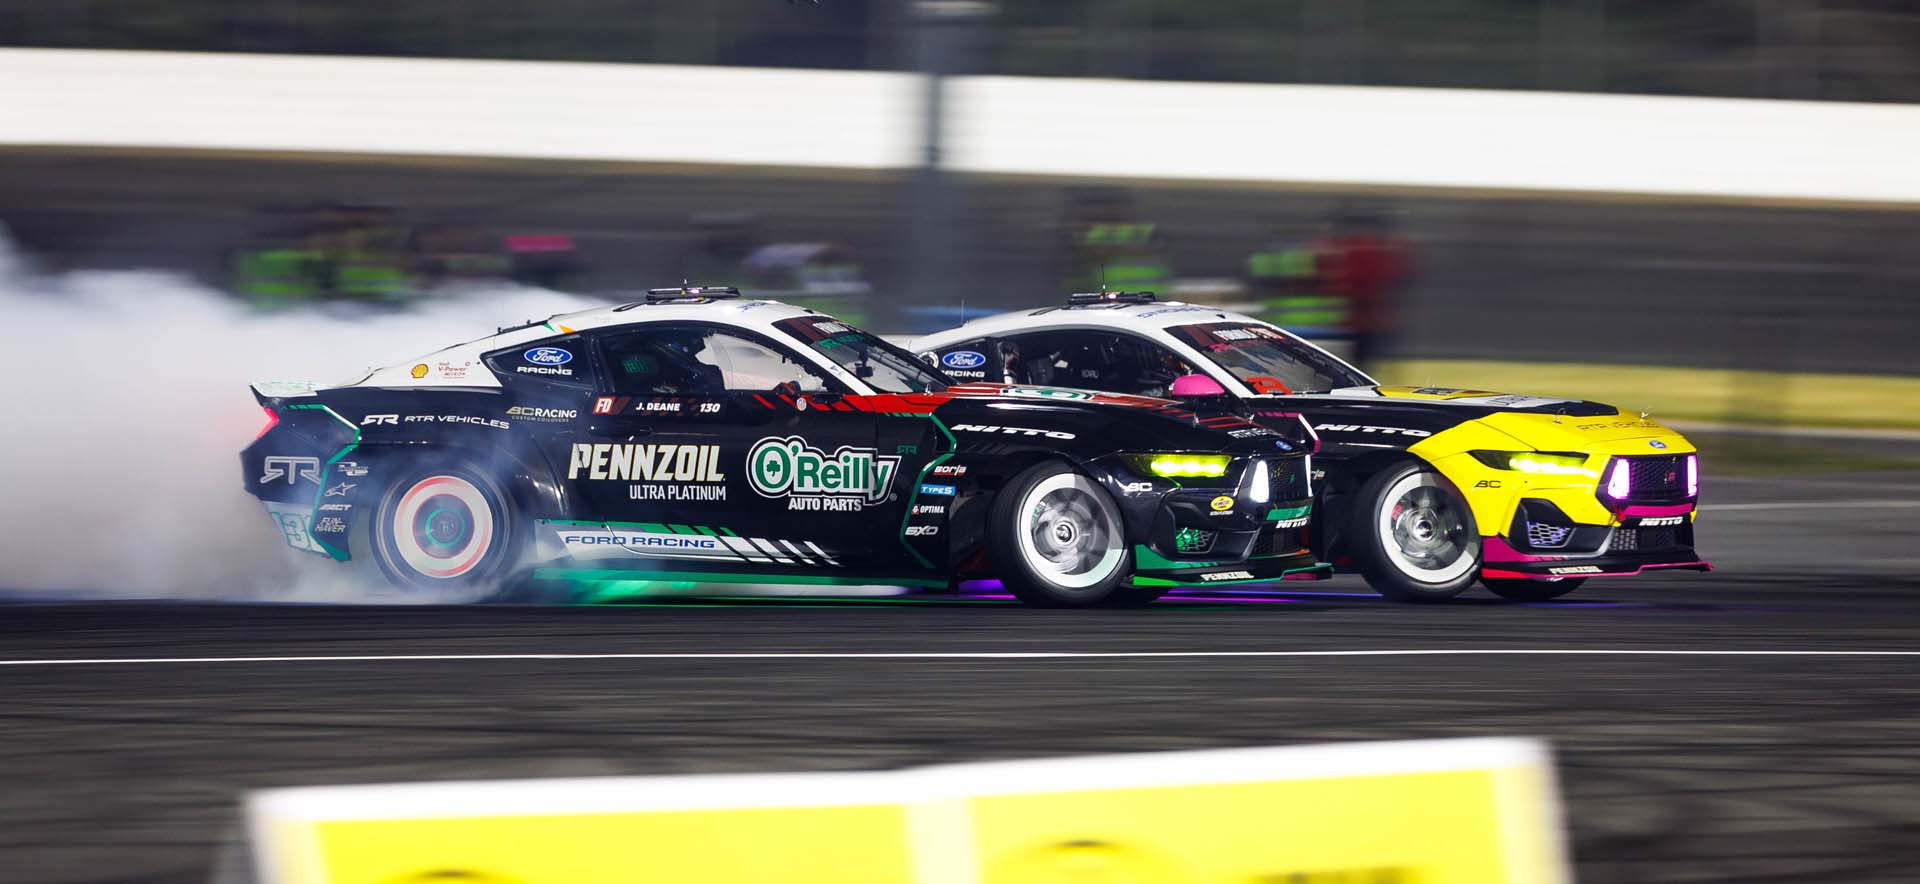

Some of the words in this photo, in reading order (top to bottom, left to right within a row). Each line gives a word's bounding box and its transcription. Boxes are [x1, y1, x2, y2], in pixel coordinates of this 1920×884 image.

[516, 366, 573, 377] RACING
[595, 398, 613, 413] FD
[635, 402, 645, 411] J.
[647, 402, 681, 412] DEANE
[700, 402, 721, 413] 130
[437, 415, 511, 430] VEHICLES
[951, 424, 1076, 440] NITTO
[1314, 423, 1432, 437] NITTO
[568, 443, 726, 482] PENNZOIL
[755, 444, 890, 496] O'Reilly
[1474, 480, 1501, 489] BC
[629, 485, 665, 500] ULTRA
[667, 485, 727, 501] PLATINUM
[788, 496, 820, 511] AUTO
[823, 497, 862, 512] PARTS
[920, 505, 945, 514] OPTIMA
[565, 536, 626, 545] FORD
[632, 536, 716, 548] RACING
